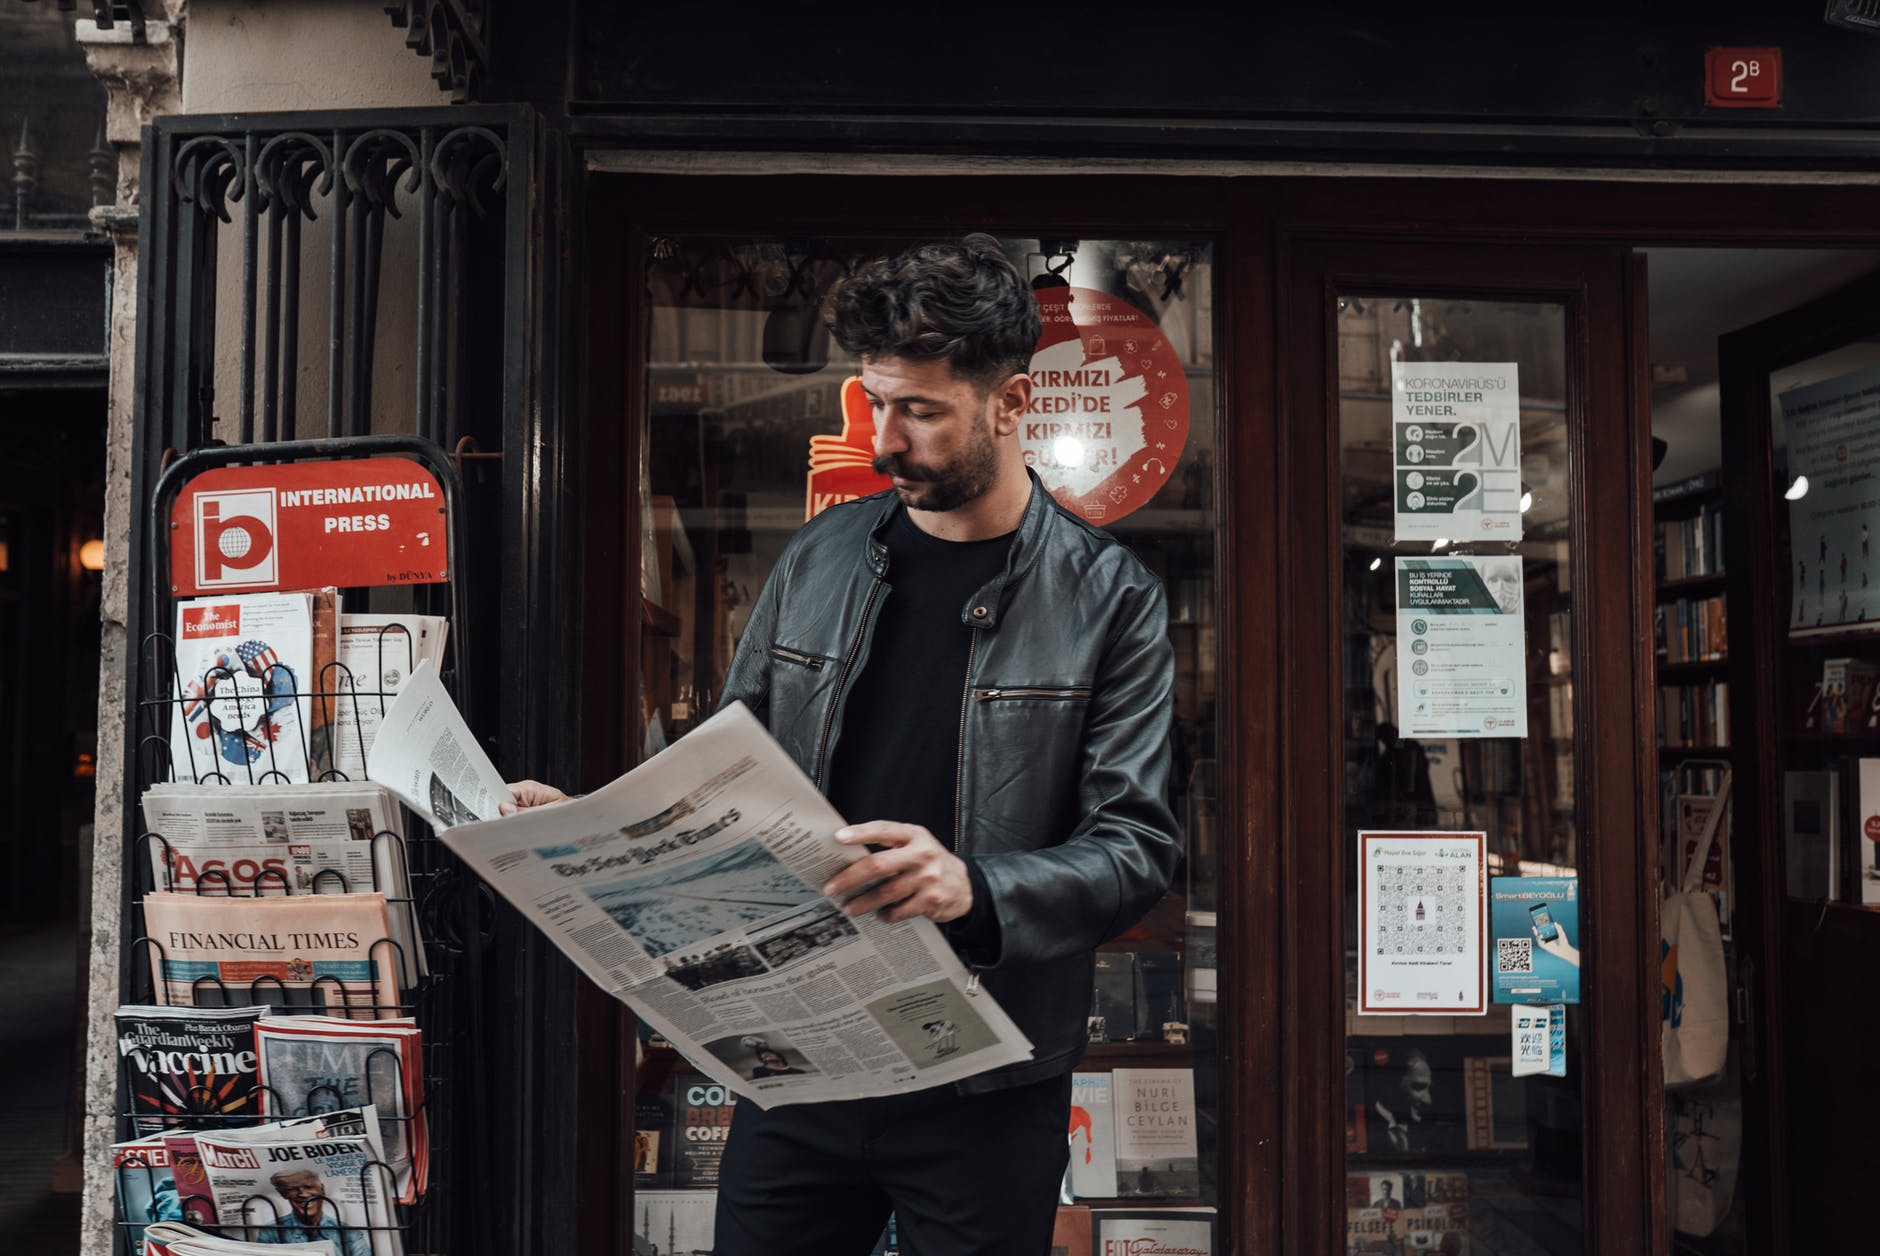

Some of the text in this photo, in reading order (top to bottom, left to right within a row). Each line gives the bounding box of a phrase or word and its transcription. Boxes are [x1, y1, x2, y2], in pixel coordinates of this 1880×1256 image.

[1029, 369, 1110, 388] KIRMIZI
[1406, 389, 1483, 403] TEDBİRLER
[1406, 405, 1457, 416] YENER.
[280, 483, 435, 507] INTERNATIONAL
[324, 514, 390, 533] PRESS
[387, 571, 433, 582] by DÜNYA
[185, 620, 237, 632] Economist
[173, 855, 288, 883] AGOS
[168, 931, 359, 950] FINANCIAL TIMES
[134, 1023, 160, 1036] The
[274, 1041, 385, 1075] TIME
[1137, 1086, 1176, 1098] NURİ
[1135, 1101, 1180, 1112] BİLGE
[1127, 1116, 1188, 1126] CEYLAN
[201, 1142, 258, 1168] MATCH
[267, 1143, 364, 1162] JOE BIDEN
